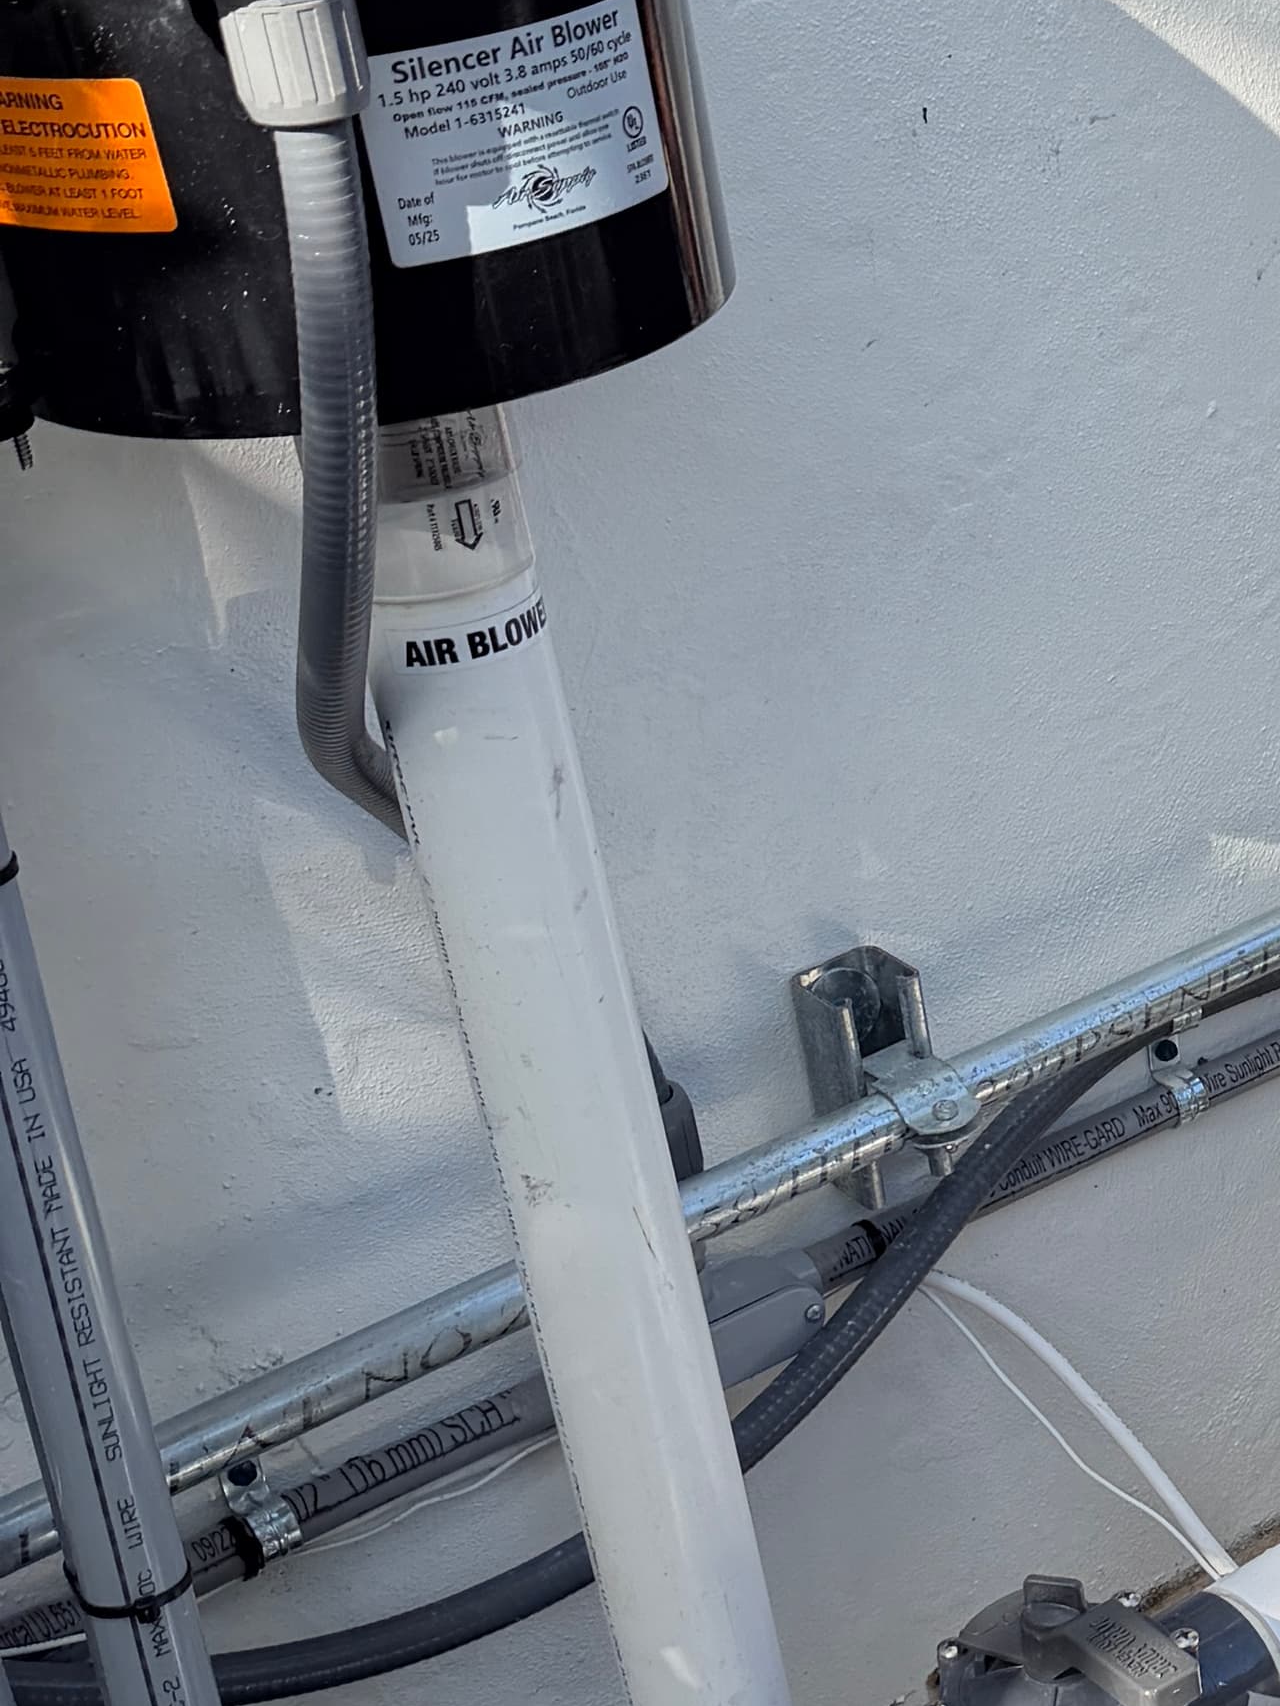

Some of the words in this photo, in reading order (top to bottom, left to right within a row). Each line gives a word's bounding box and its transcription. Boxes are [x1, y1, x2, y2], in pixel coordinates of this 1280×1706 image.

[391, 46, 501, 84] Silencer
[510, 32, 545, 60] Air
[551, 9, 619, 48] Blower
[377, 90, 404, 108] 1.5
[408, 88, 432, 105] hp
[436, 79, 466, 98] 240
[470, 71, 501, 91] volt
[504, 64, 528, 83] 3.8
[531, 55, 569, 76] amps
[571, 40, 605, 64] 50/60
[607, 30, 633, 53] cycle
[567, 75, 609, 99] Outdoor
[610, 69, 628, 83] Use
[1, 118, 147, 139] ELECTROCUTION
[393, 110, 424, 124] Open
[428, 104, 453, 116] flow
[403, 119, 451, 140] Model
[454, 103, 525, 130] 1-6315241
[497, 110, 564, 139] WARNING
[103, 148, 147, 160] WATER
[64, 187, 98, 199] LEAST
[110, 188, 144, 200] FOOT
[398, 195, 422, 210] Date
[424, 191, 435, 205] of
[408, 212, 433, 228] Mfg:
[408, 229, 440, 247] 05/25
[406, 638, 461, 668] AIR
[466, 596, 548, 660] BLOWE
[12, 1056, 37, 1106] USA
[23, 1110, 46, 1144] IN
[1049, 1116, 1127, 1171] WIRE-GARD
[1133, 1102, 1164, 1128] Max
[1224, 1050, 1275, 1085] Sunlight
[34, 1155, 64, 1218] MADE
[50, 1226, 96, 1346] RESISTANT
[83, 1357, 123, 1463] SUNLIGHT
[441, 1398, 504, 1444] SCH
[116, 1494, 144, 1551] WIRE
